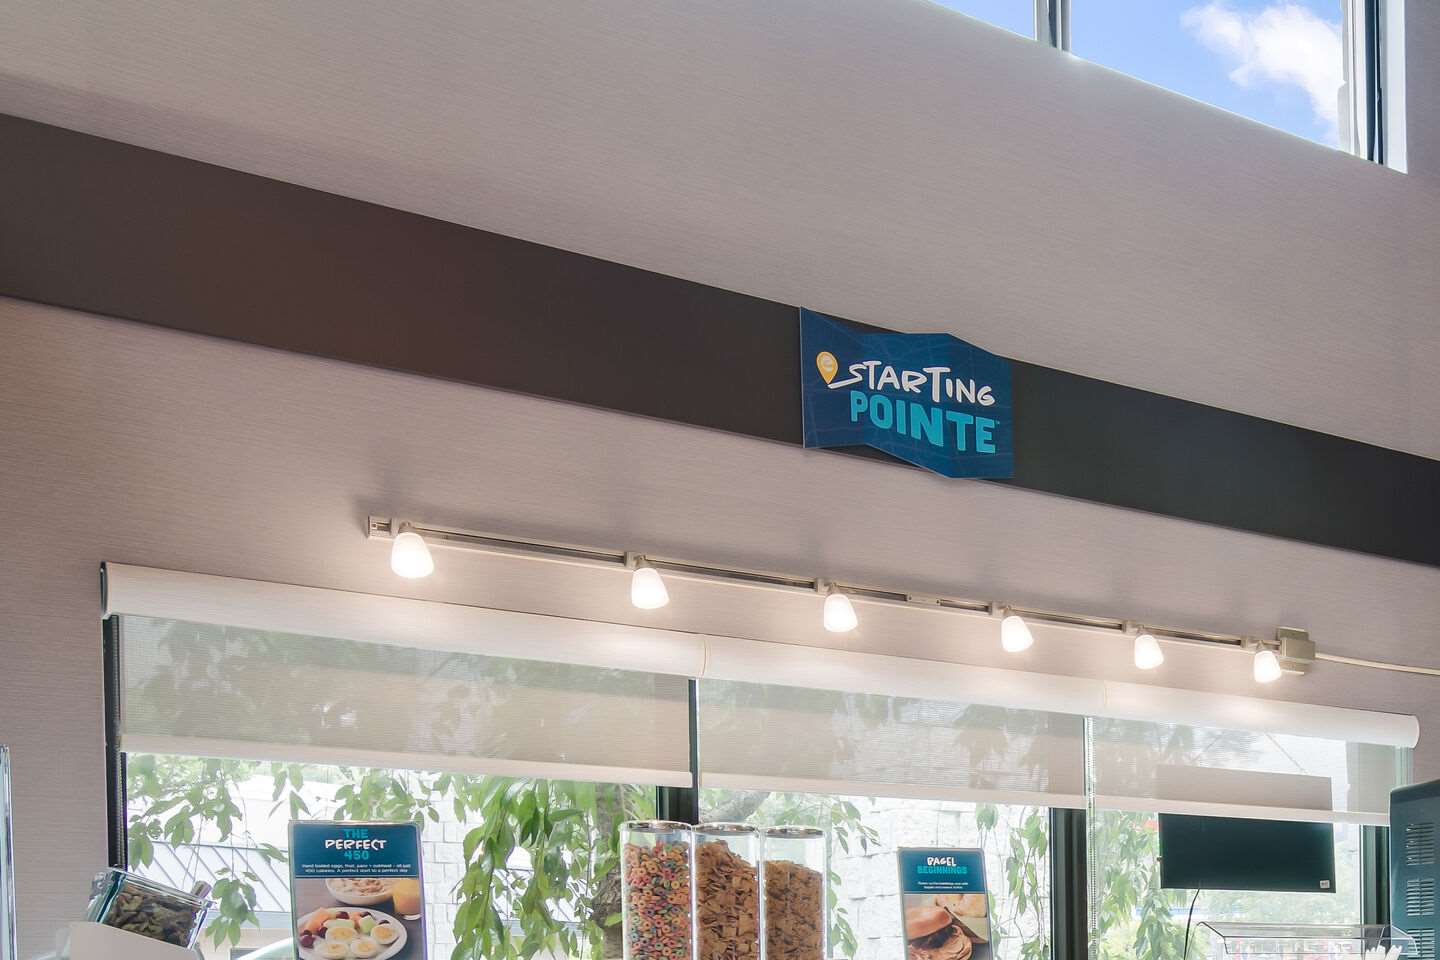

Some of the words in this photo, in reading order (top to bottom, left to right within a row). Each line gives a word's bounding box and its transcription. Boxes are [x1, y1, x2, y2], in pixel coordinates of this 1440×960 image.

[828, 360, 996, 407] STARTING
[849, 390, 997, 454] POINTE
[343, 828, 369, 839] THE
[325, 839, 388, 851] PERFECT
[343, 850, 370, 860] 450
[927, 856, 957, 867] BAGEL
[917, 865, 968, 875] BEGINNINGS
